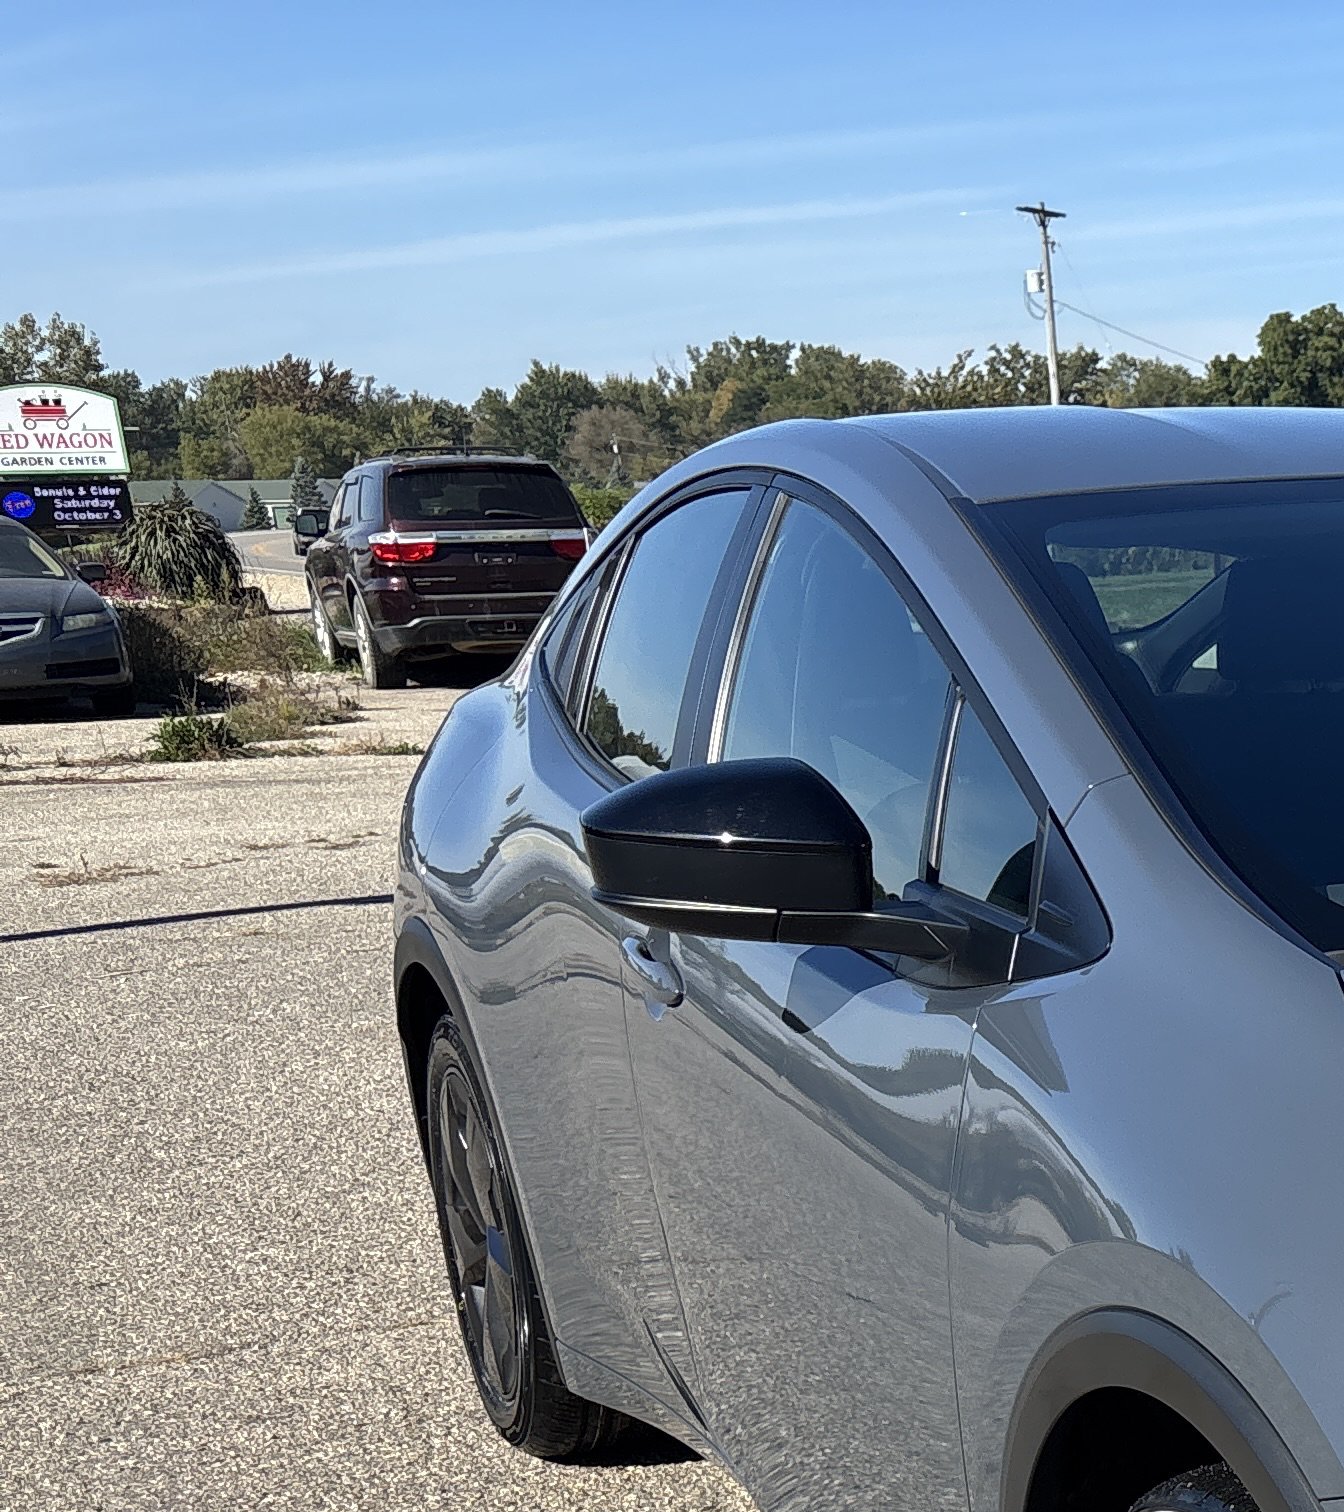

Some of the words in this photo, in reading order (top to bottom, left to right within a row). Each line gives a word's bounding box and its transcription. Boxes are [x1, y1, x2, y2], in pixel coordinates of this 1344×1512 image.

[0, 432, 29, 449] ED
[33, 432, 113, 449] WAGON
[1, 456, 54, 467] GARDEN
[59, 455, 107, 466] CENTER
[90, 485, 121, 496] Cider
[53, 498, 116, 510] Saturday
[53, 510, 109, 520] October
[112, 509, 122, 520] 3
